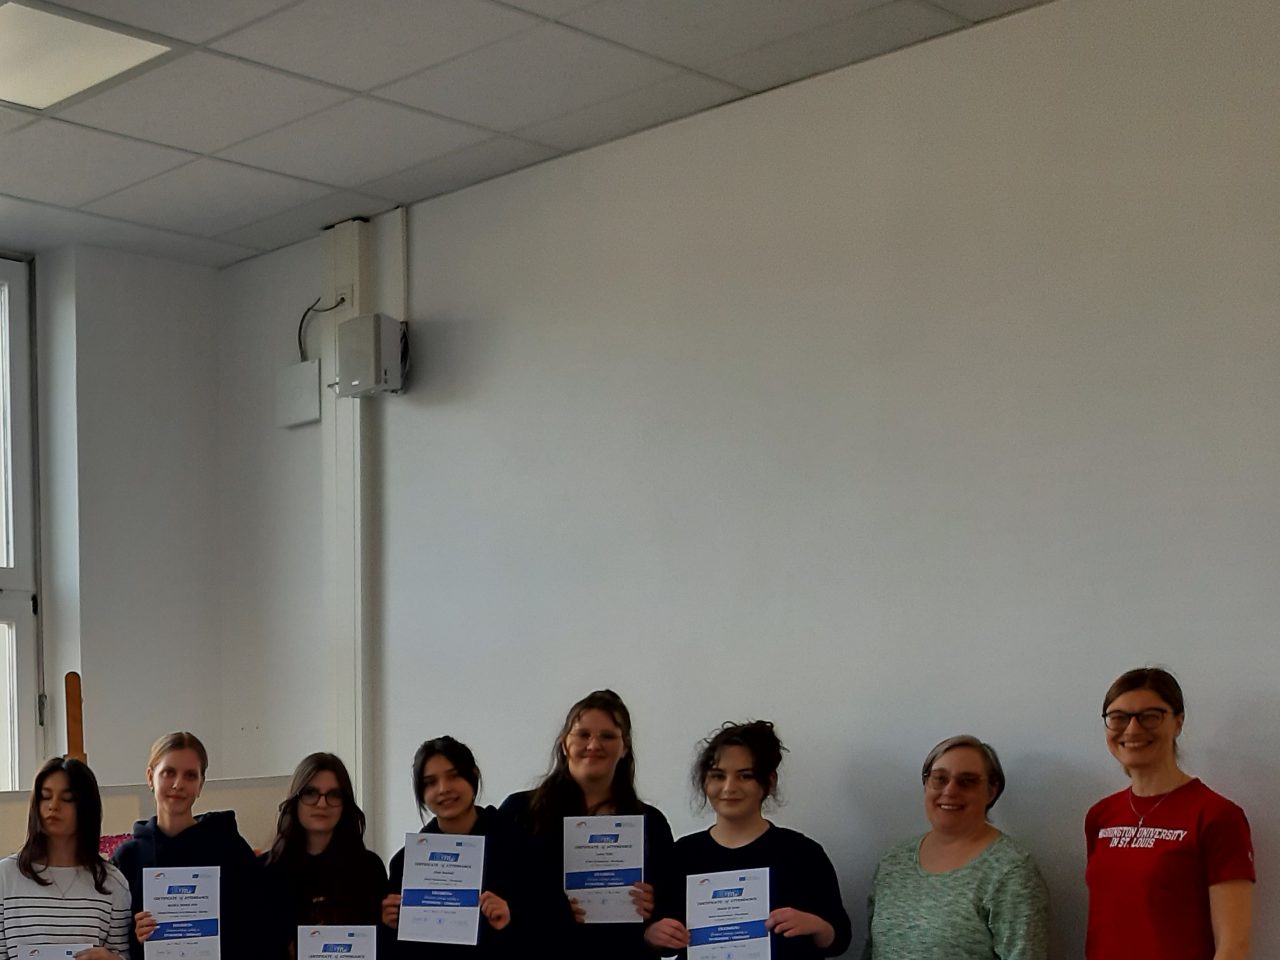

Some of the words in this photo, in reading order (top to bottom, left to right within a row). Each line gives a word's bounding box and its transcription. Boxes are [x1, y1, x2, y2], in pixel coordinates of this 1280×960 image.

[1137, 827, 1188, 841] UNIVERSITY
[1109, 838, 1119, 849] IN
[1119, 838, 1131, 849] ST.
[1131, 838, 1156, 849] LOUIS
